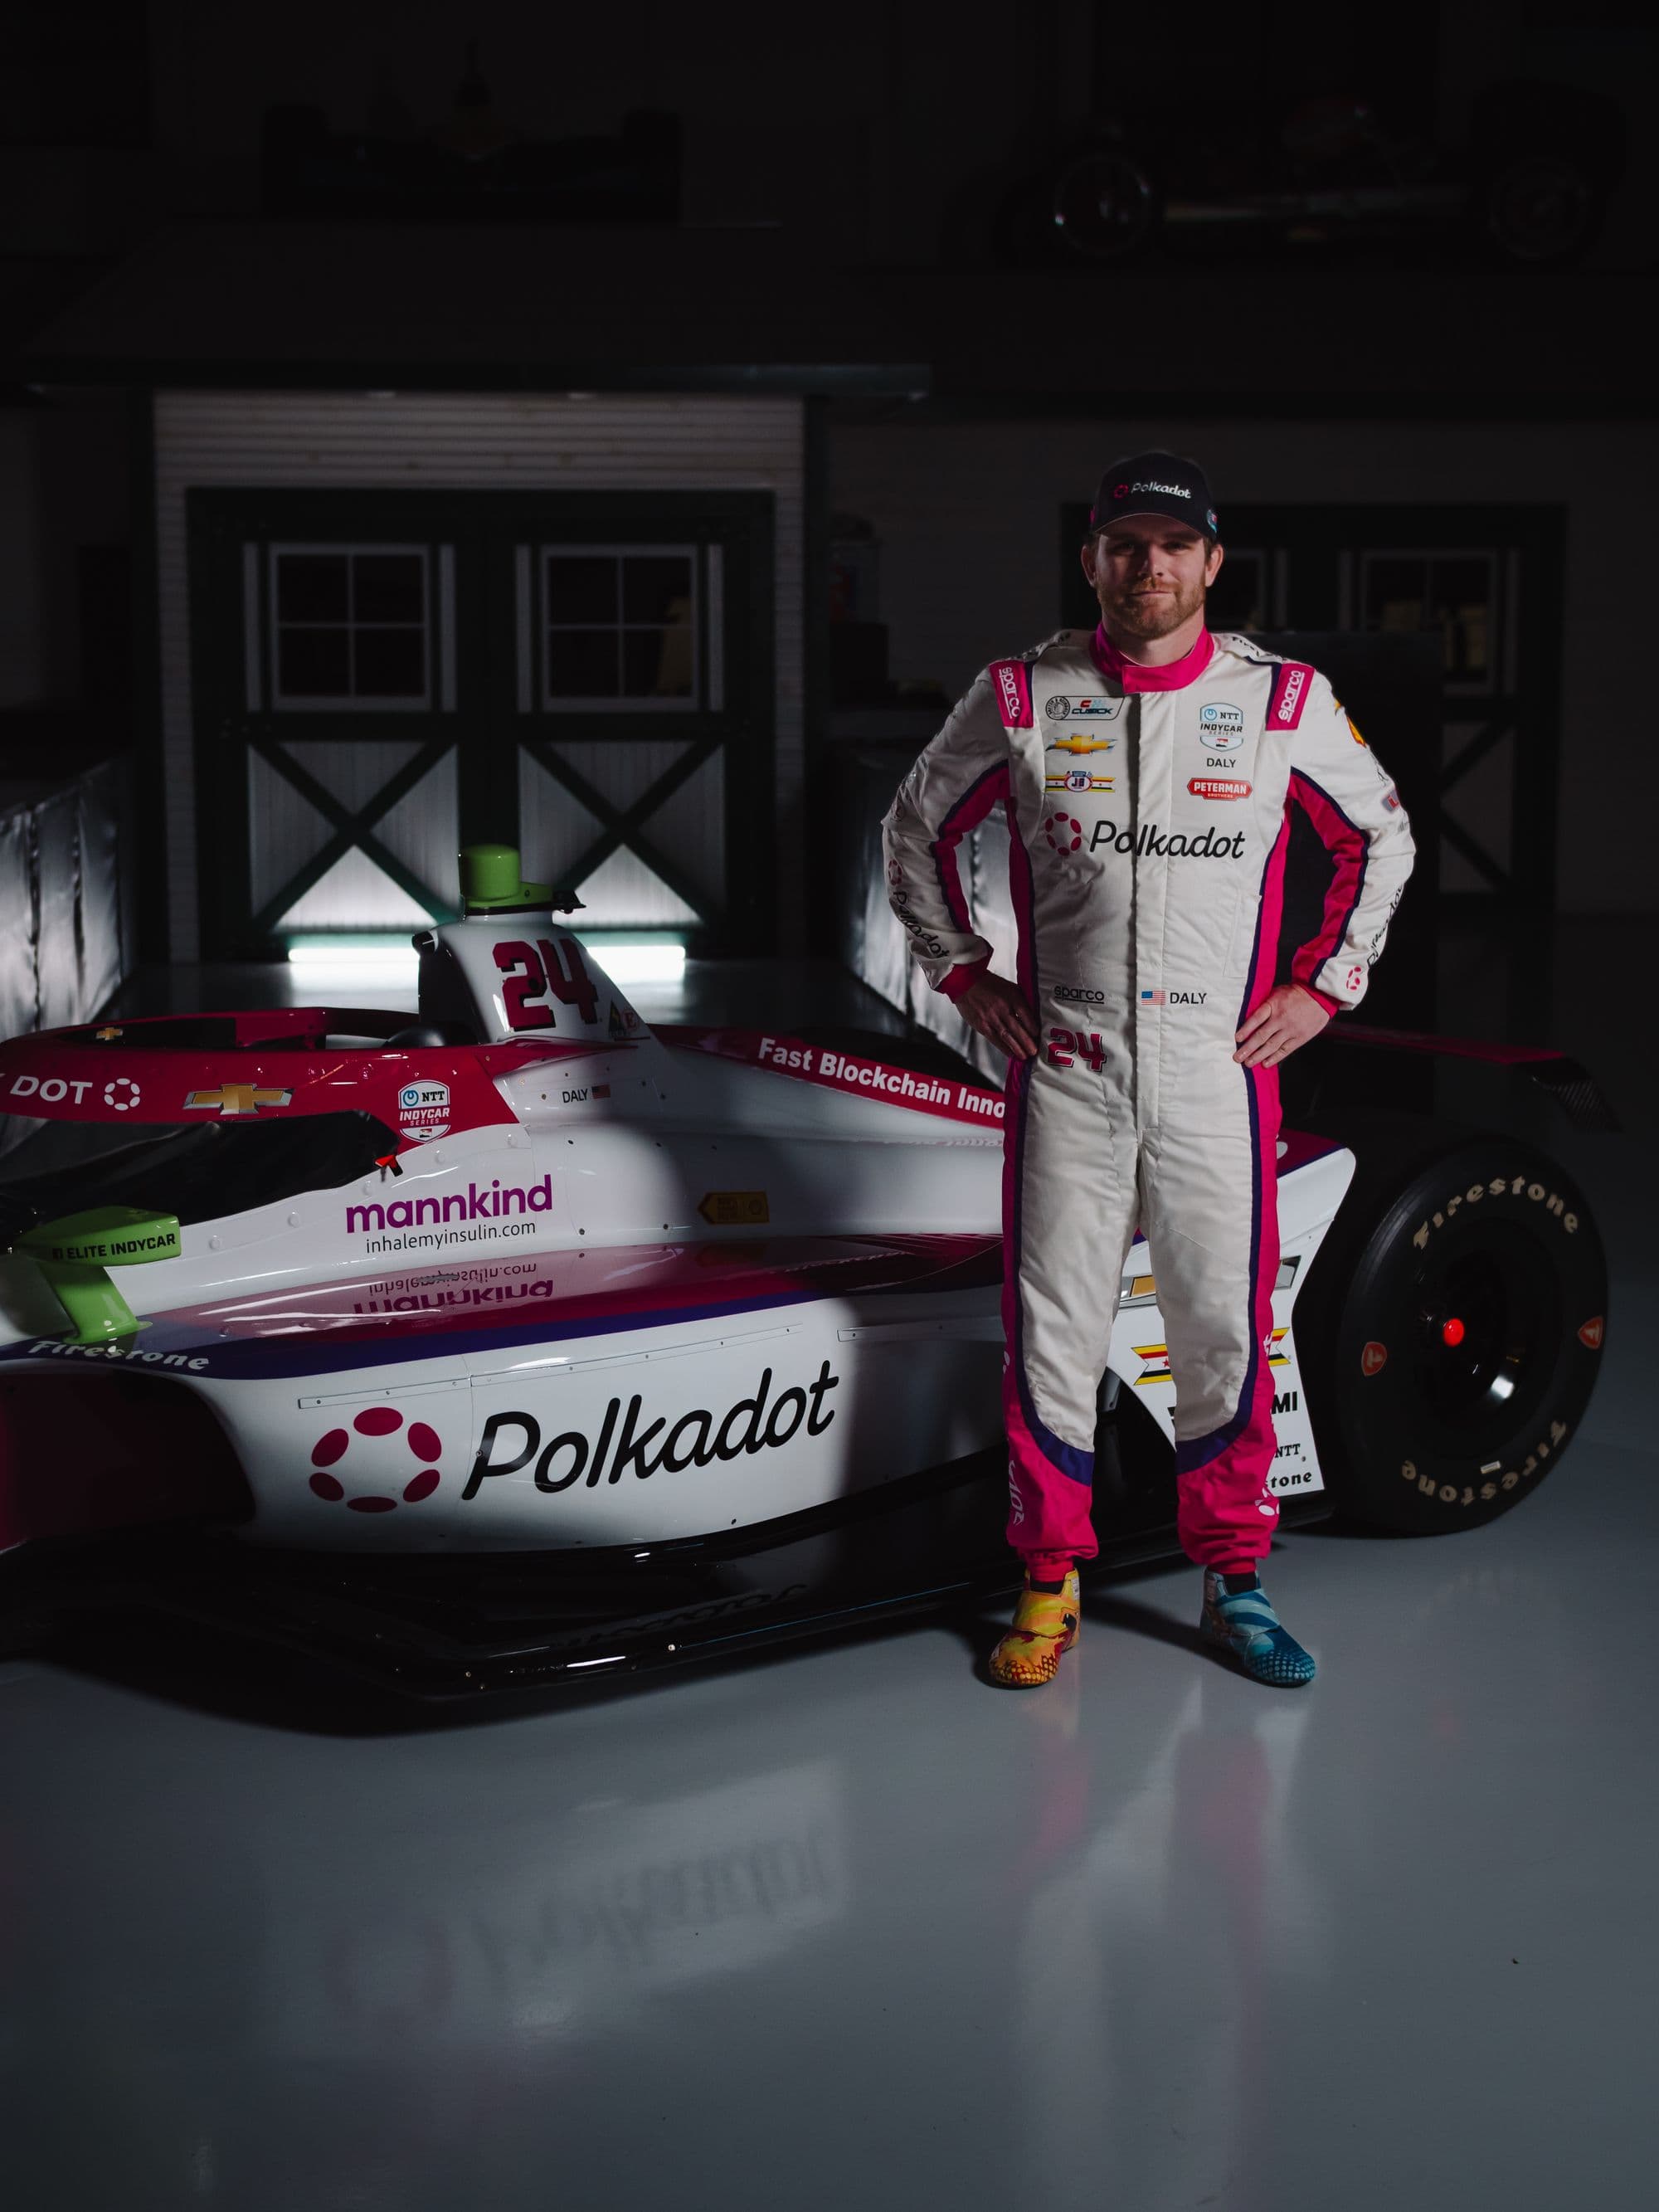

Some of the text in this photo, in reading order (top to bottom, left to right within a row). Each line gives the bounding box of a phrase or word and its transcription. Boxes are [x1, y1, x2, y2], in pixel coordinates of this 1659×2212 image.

[1000, 666, 1021, 719] sparco
[1278, 670, 1304, 723] sparco
[1200, 723, 1243, 733] INDYCAR
[1220, 712, 1239, 720] NTT
[1206, 758, 1236, 767] DALY
[1194, 782, 1247, 795] PETERMAN
[1089, 820, 1245, 859] Polkadot
[492, 938, 599, 1032] 24
[1053, 985, 1105, 1002] sparco
[1170, 992, 1208, 1005] DALY
[1048, 1027, 1107, 1072] 24
[758, 1037, 813, 1071] Fast
[819, 1052, 951, 1105] Blockchain
[10, 1075, 93, 1104] DOT
[421, 1090, 445, 1102] NTT
[562, 1088, 588, 1103] DALY
[399, 1108, 450, 1122] INDYCAR
[411, 1118, 440, 1127] SERIES
[347, 1174, 552, 1234] mannkind
[1413, 1175, 1579, 1250] Firestone
[66, 1245, 107, 1259] ELITE
[111, 1233, 176, 1255] INDYCAR
[366, 1222, 536, 1254] inhalemyinsulin.com
[28, 1341, 209, 1370] Firestone
[461, 1360, 839, 1501] Polkadot
[1401, 1420, 1566, 1508] Firestone
